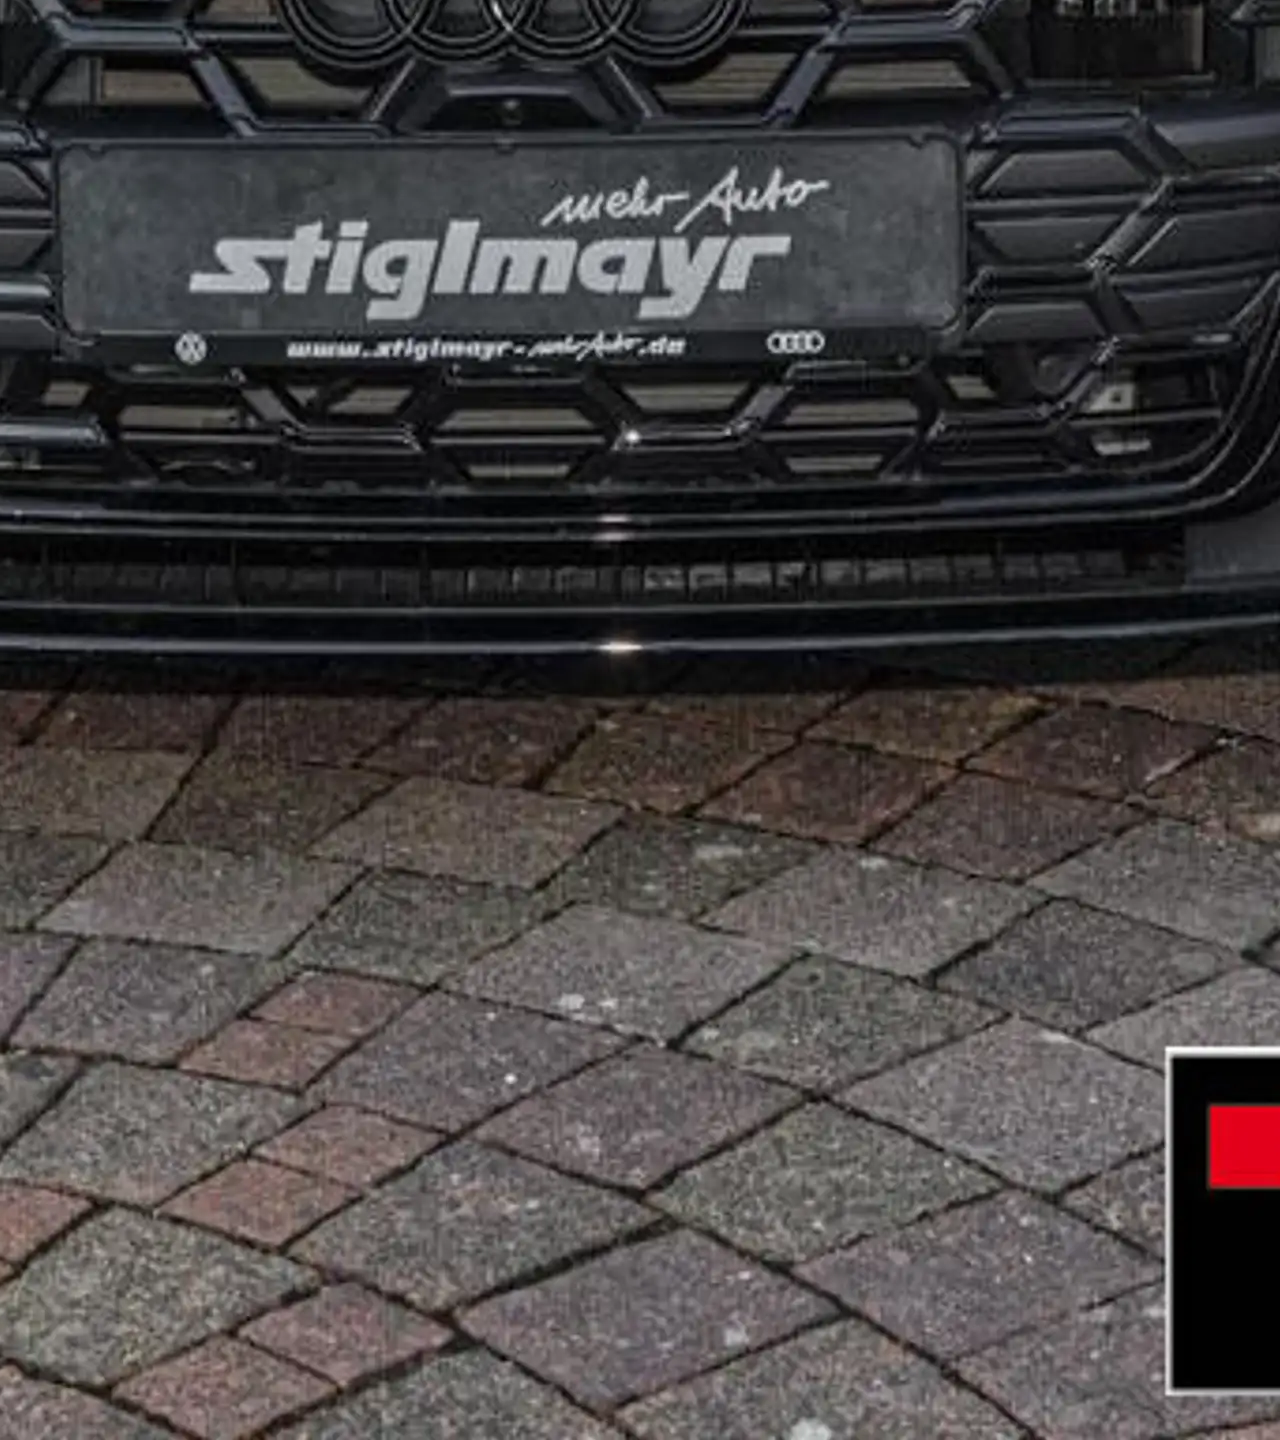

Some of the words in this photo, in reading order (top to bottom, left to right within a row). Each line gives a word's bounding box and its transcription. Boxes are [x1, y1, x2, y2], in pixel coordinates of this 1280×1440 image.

[540, 176, 689, 226] mehr
[674, 166, 830, 233] Auto
[189, 220, 791, 320] stiglmayr
